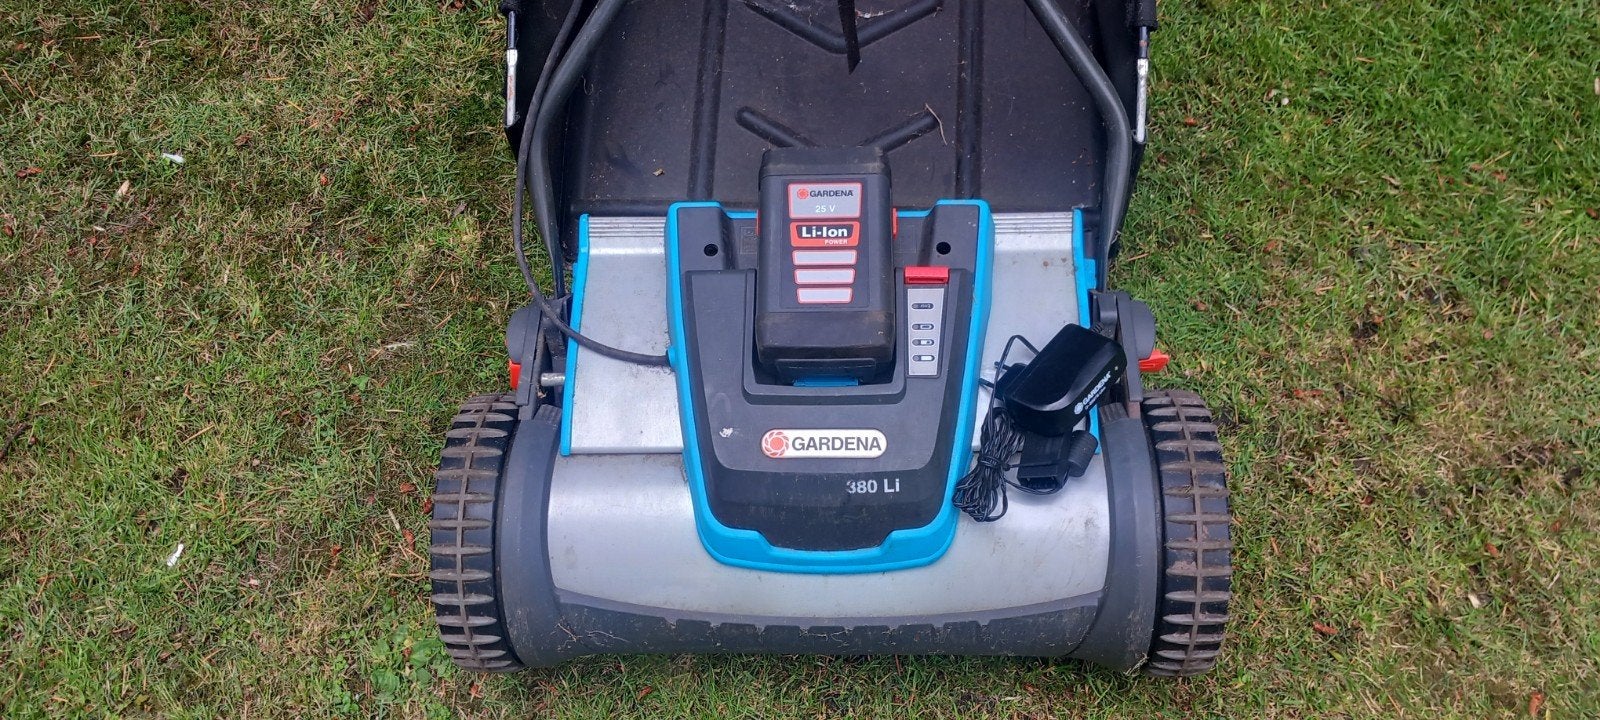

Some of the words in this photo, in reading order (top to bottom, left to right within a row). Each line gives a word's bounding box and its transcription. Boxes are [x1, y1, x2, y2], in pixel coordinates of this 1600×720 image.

[815, 205, 826, 213] 25
[829, 204, 836, 213] V
[801, 226, 848, 238] Li-Ion
[1083, 370, 1110, 405] GARDENA
[791, 436, 882, 451] GARDENA
[846, 479, 878, 494] 380
[883, 478, 900, 493] Li
